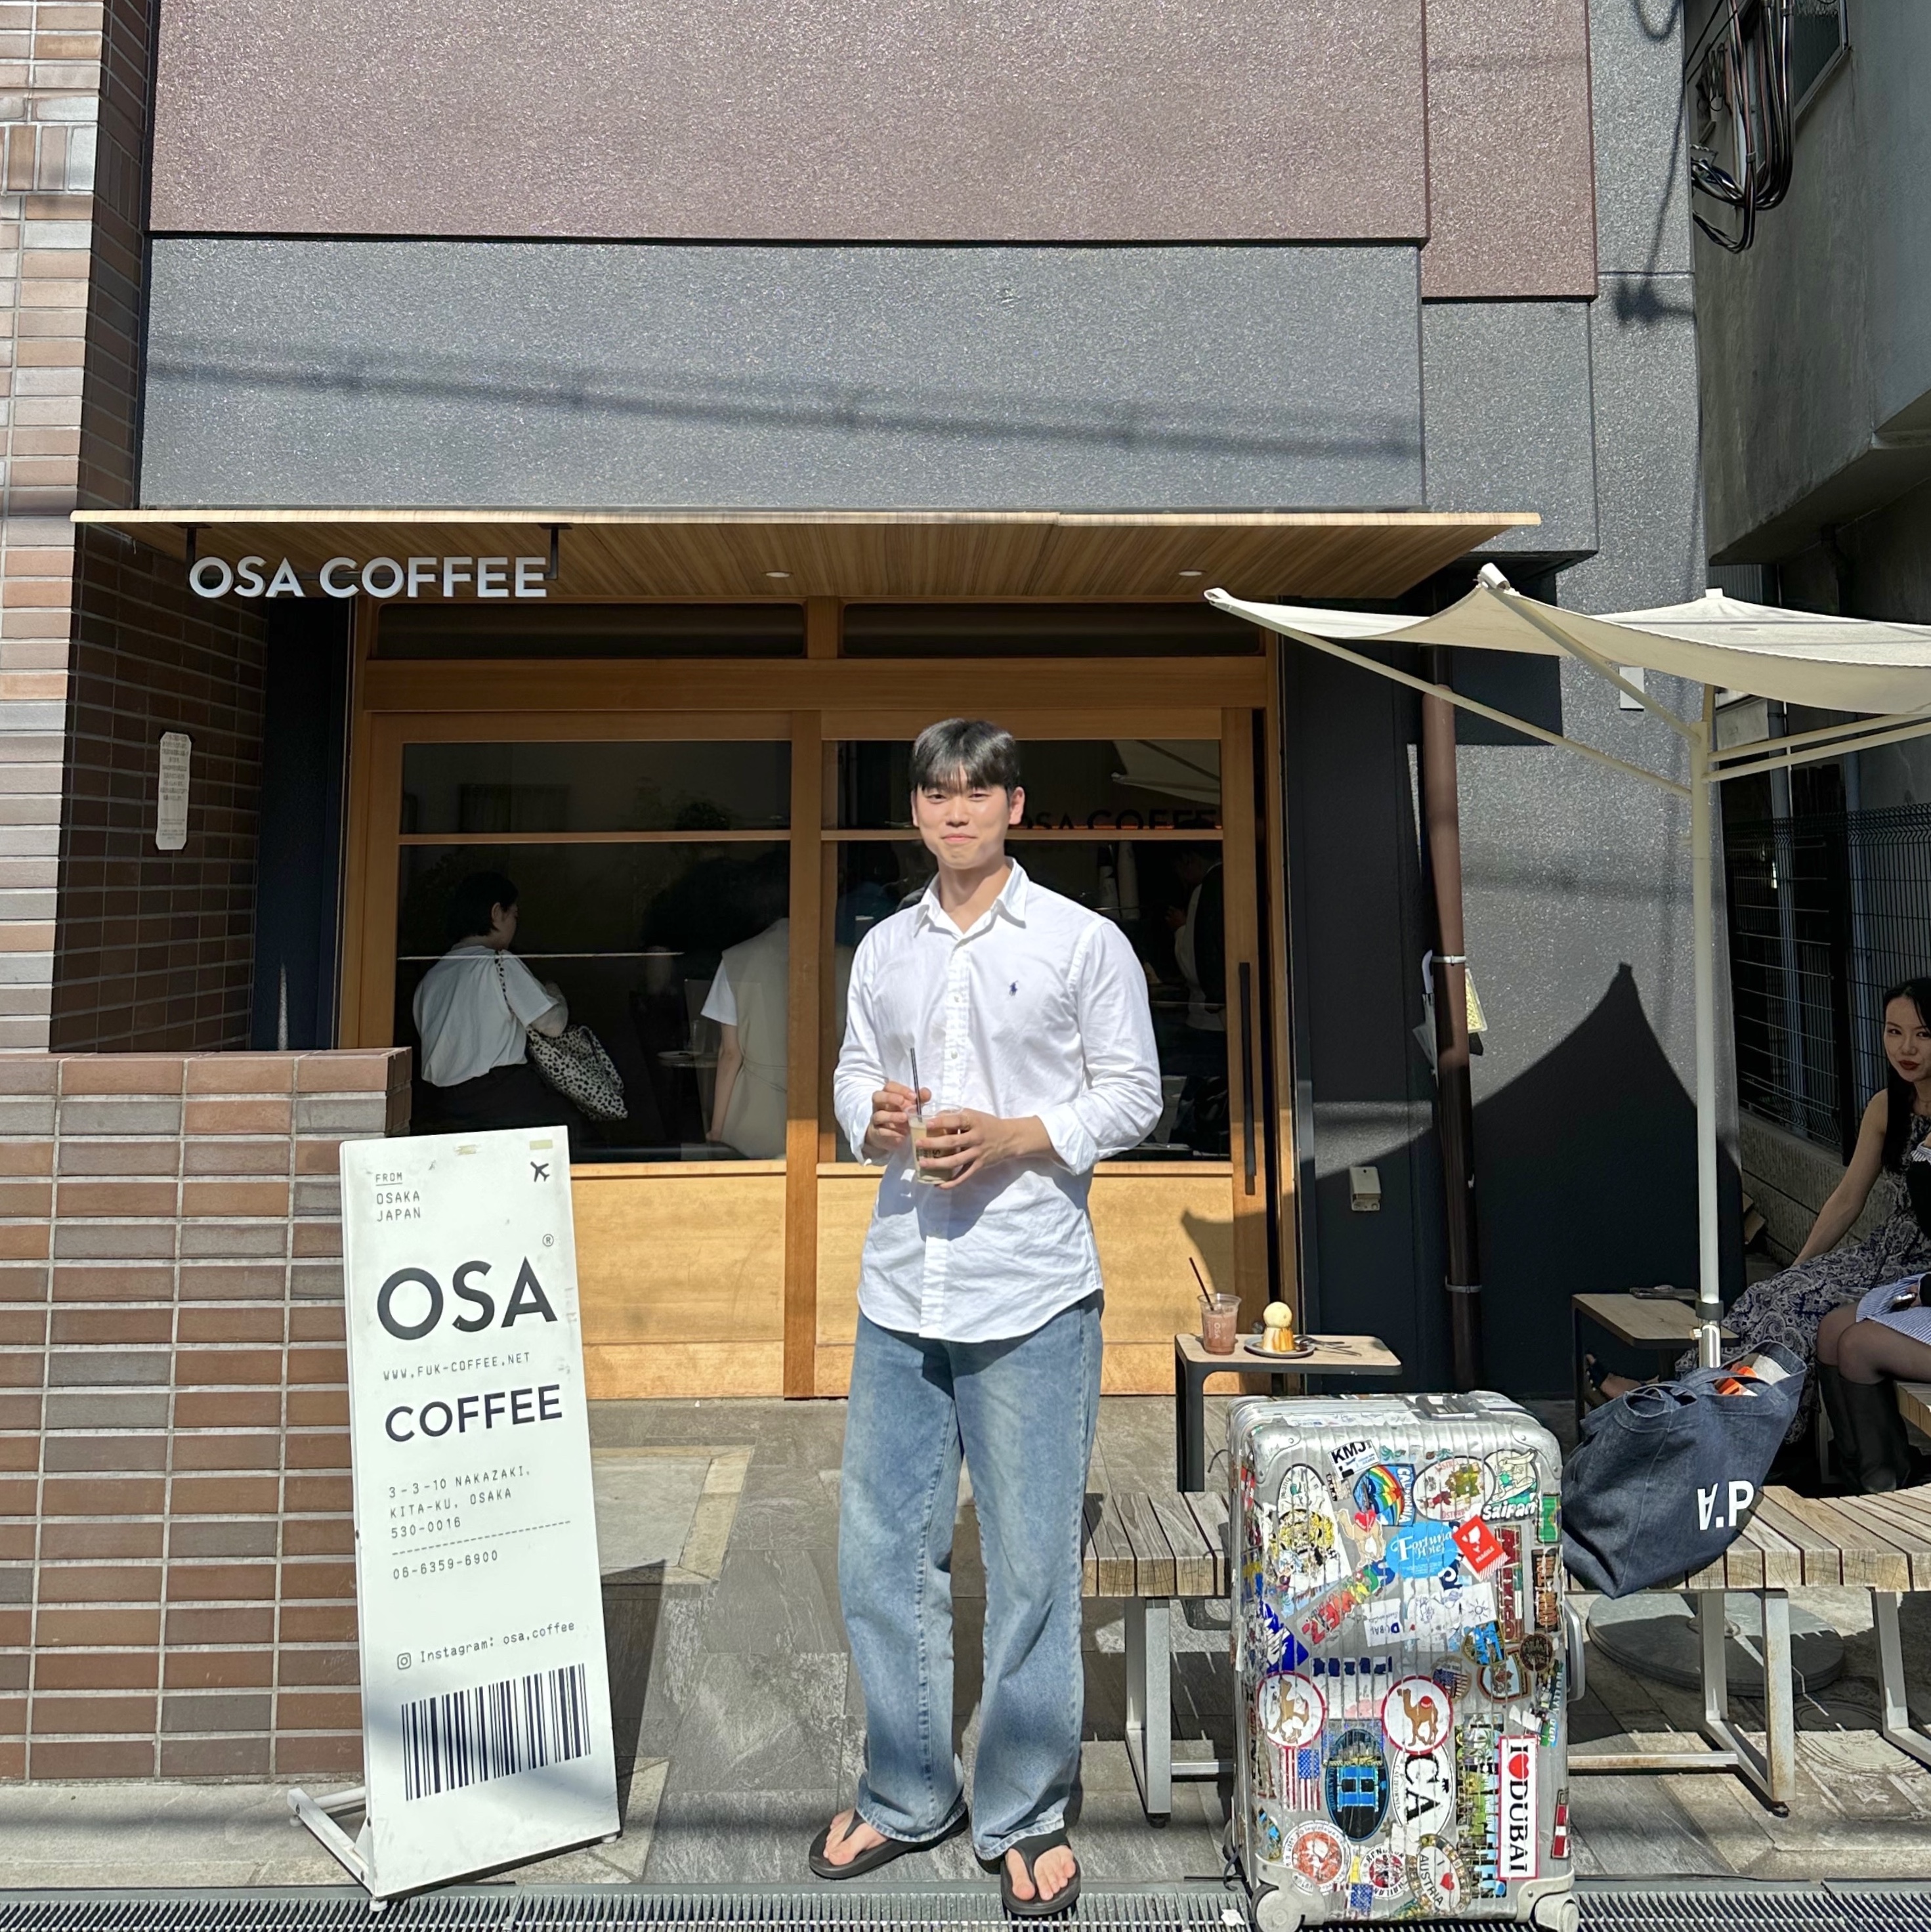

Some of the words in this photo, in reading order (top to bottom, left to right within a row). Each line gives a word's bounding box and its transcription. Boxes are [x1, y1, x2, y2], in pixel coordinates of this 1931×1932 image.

[189, 556, 306, 598] OSA
[319, 556, 547, 598] COFFEE
[375, 1172, 402, 1182] FROM
[377, 1190, 420, 1205] OSAKA
[377, 1207, 421, 1222] JAPAN
[377, 1256, 558, 1341] OSA
[383, 1352, 530, 1381] WWW.FUK-COFFEE.NET
[385, 1384, 562, 1442] COFFEE
[391, 1497, 458, 1518] KITA-KU,
[470, 1488, 511, 1505] OSAKA
[391, 1516, 461, 1539] 530-0016
[393, 1549, 498, 1579] 06-6359-6900
[420, 1637, 494, 1663] Instagram:
[503, 1621, 575, 1645] osa.coffee
[1510, 1745, 1528, 1753] I
[1405, 1753, 1441, 1824] CA
[1510, 1780, 1528, 1872] DUBAI
[1419, 1855, 1445, 1906] AUSTRIA
